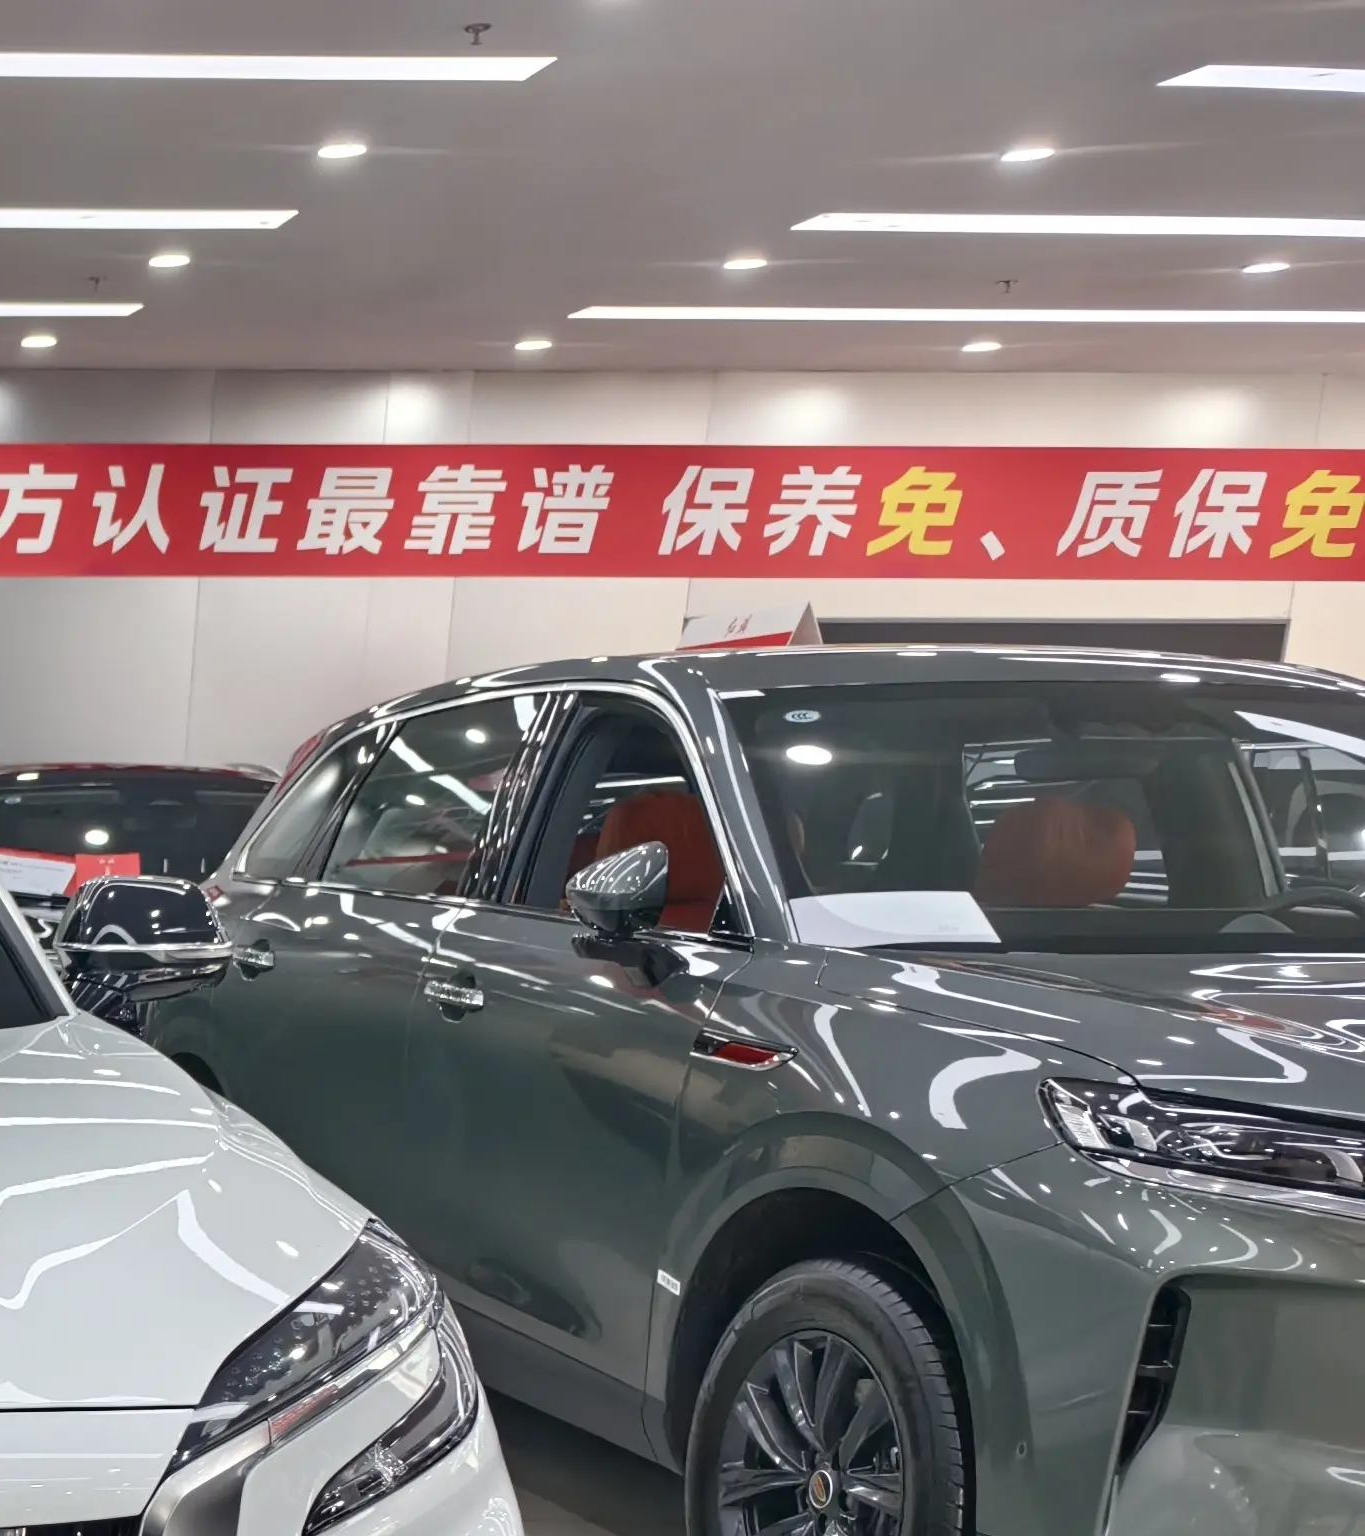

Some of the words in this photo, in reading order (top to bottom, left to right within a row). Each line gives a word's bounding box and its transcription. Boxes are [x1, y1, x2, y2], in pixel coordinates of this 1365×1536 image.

[657, 465, 1365, 562] 保养免、质保免
